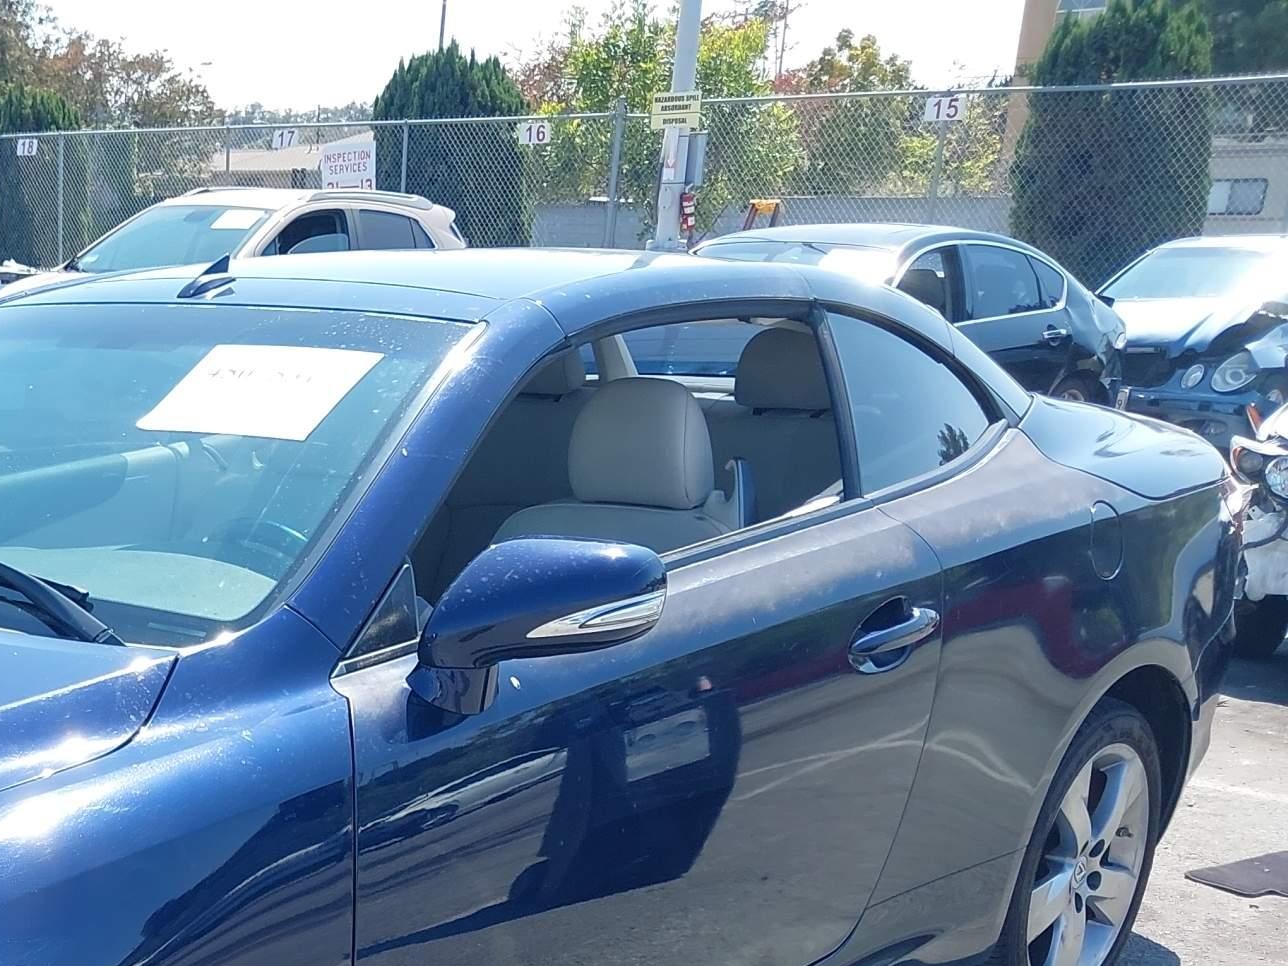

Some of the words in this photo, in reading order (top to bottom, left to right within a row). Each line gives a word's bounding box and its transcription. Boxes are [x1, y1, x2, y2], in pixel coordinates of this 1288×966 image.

[654, 95, 685, 103] HAZARDOUS
[933, 98, 960, 119] 15
[662, 117, 687, 125] DISPOSAL
[278, 130, 295, 147] 17
[526, 124, 546, 143] 16
[20, 140, 33, 155] 18
[324, 150, 371, 163] INSPECTION
[328, 161, 368, 176] SERVICES
